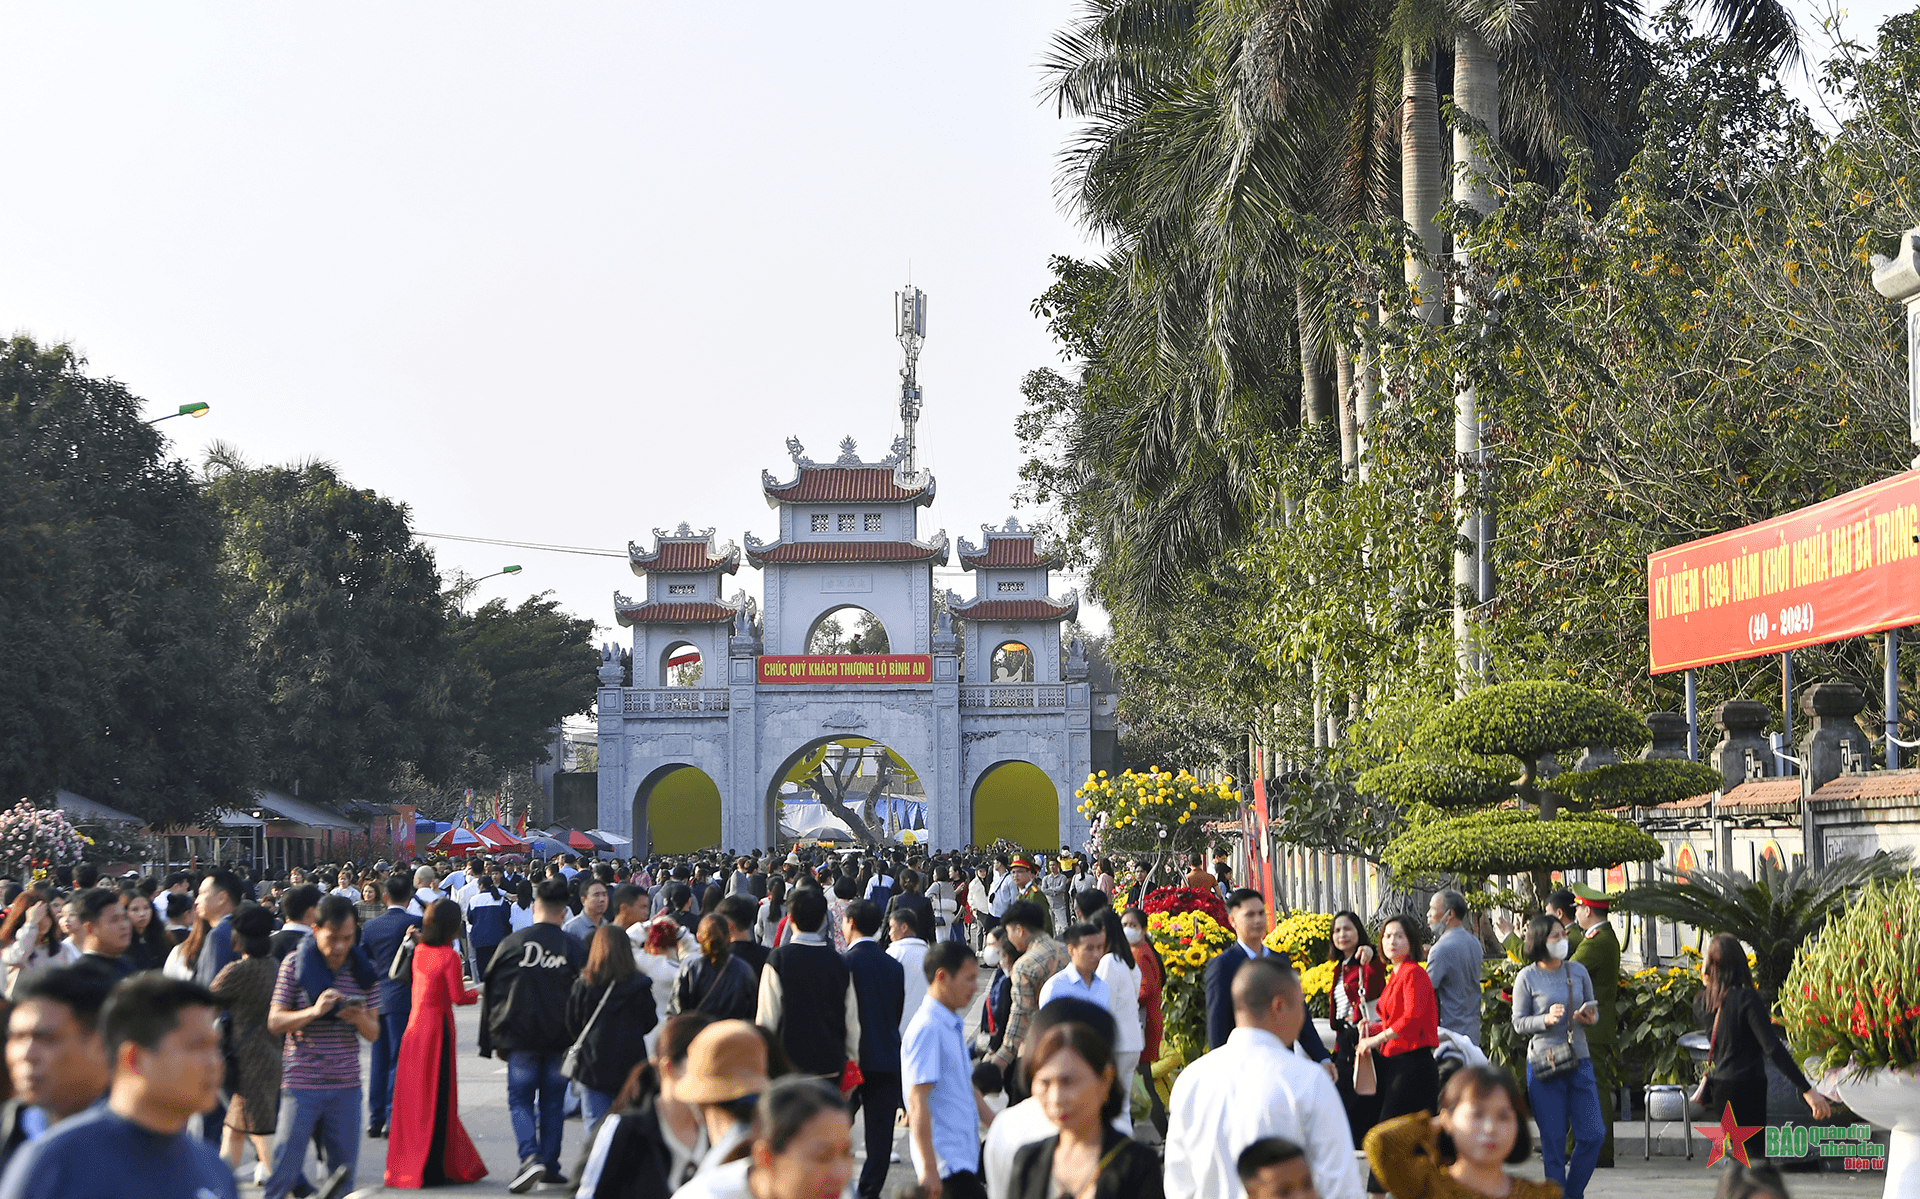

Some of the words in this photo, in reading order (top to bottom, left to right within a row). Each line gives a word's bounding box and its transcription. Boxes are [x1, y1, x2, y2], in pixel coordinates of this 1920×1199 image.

[1655, 561, 1669, 620] KỶ
[1670, 561, 1700, 623] NIỆM
[1702, 561, 1730, 609] 1984
[1732, 545, 1760, 603] NĂM
[1762, 529, 1790, 596] KHỞI
[1793, 524, 1829, 589] NGHĨA
[1831, 524, 1852, 578] HAI
[1855, 507, 1873, 572] BÀ
[1875, 503, 1918, 566] TRƯNG
[1748, 612, 1769, 645] (40
[1780, 602, 1814, 637] 2024)
[764, 660, 787, 676] CHÚC
[789, 660, 806, 677] QUÝ
[809, 660, 838, 676] KHÁCH
[840, 661, 874, 679] THƯỢNG
[876, 660, 887, 679] LỘ
[889, 660, 910, 676] BÌNH
[912, 662, 925, 676] AN
[518, 941, 568, 969] Dior
